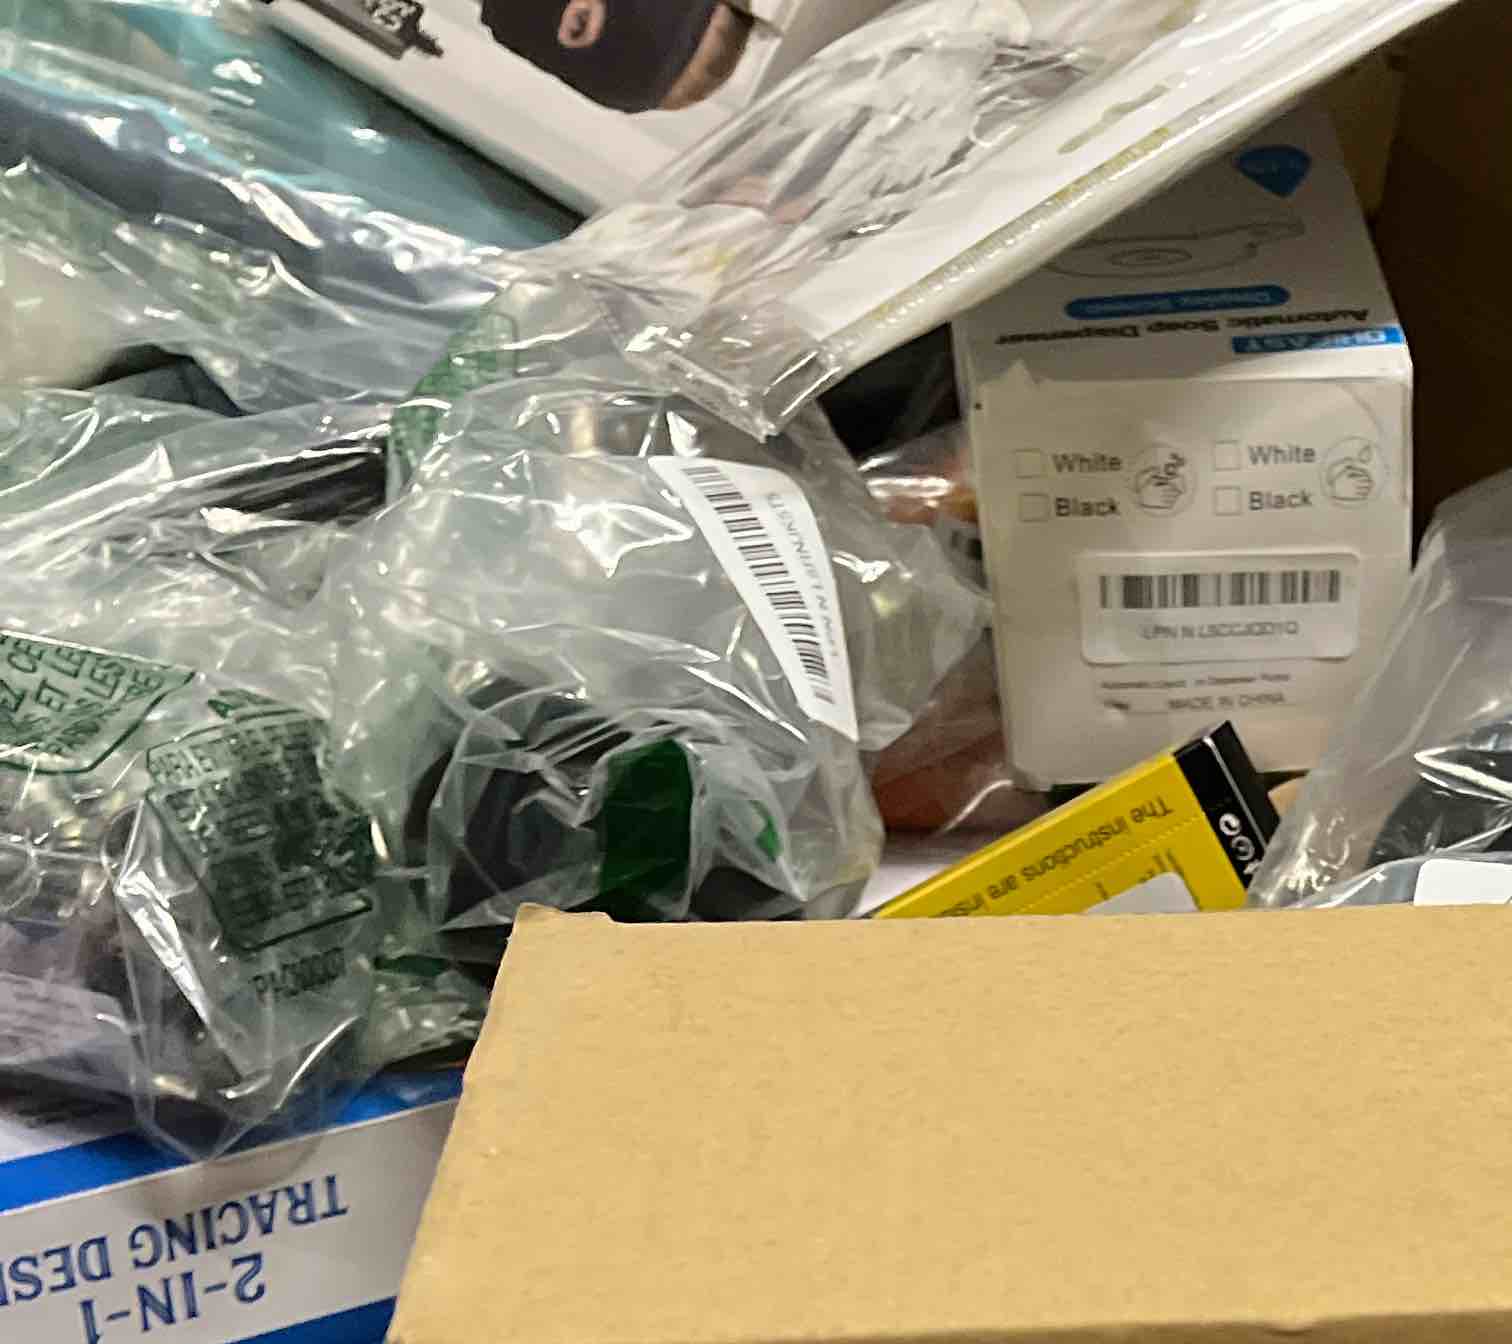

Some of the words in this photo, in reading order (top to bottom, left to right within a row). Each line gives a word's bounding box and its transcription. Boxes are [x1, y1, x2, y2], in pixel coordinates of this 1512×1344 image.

[1146, 317, 1221, 337] Soap
[1227, 307, 1370, 329] Automatic
[1052, 453, 1123, 473] White
[1248, 445, 1317, 466] White
[1055, 497, 1121, 518] Black
[1248, 489, 1313, 512] Black
[35, 679, 70, 713] ET
[1218, 694, 1234, 708] IN
[1238, 691, 1286, 708] CHINA
[1131, 794, 1176, 823] The
[1021, 815, 1130, 883] instructions
[986, 873, 1018, 901] are
[128, 1173, 349, 1270] TRACING
[0, 1235, 112, 1309] DES
